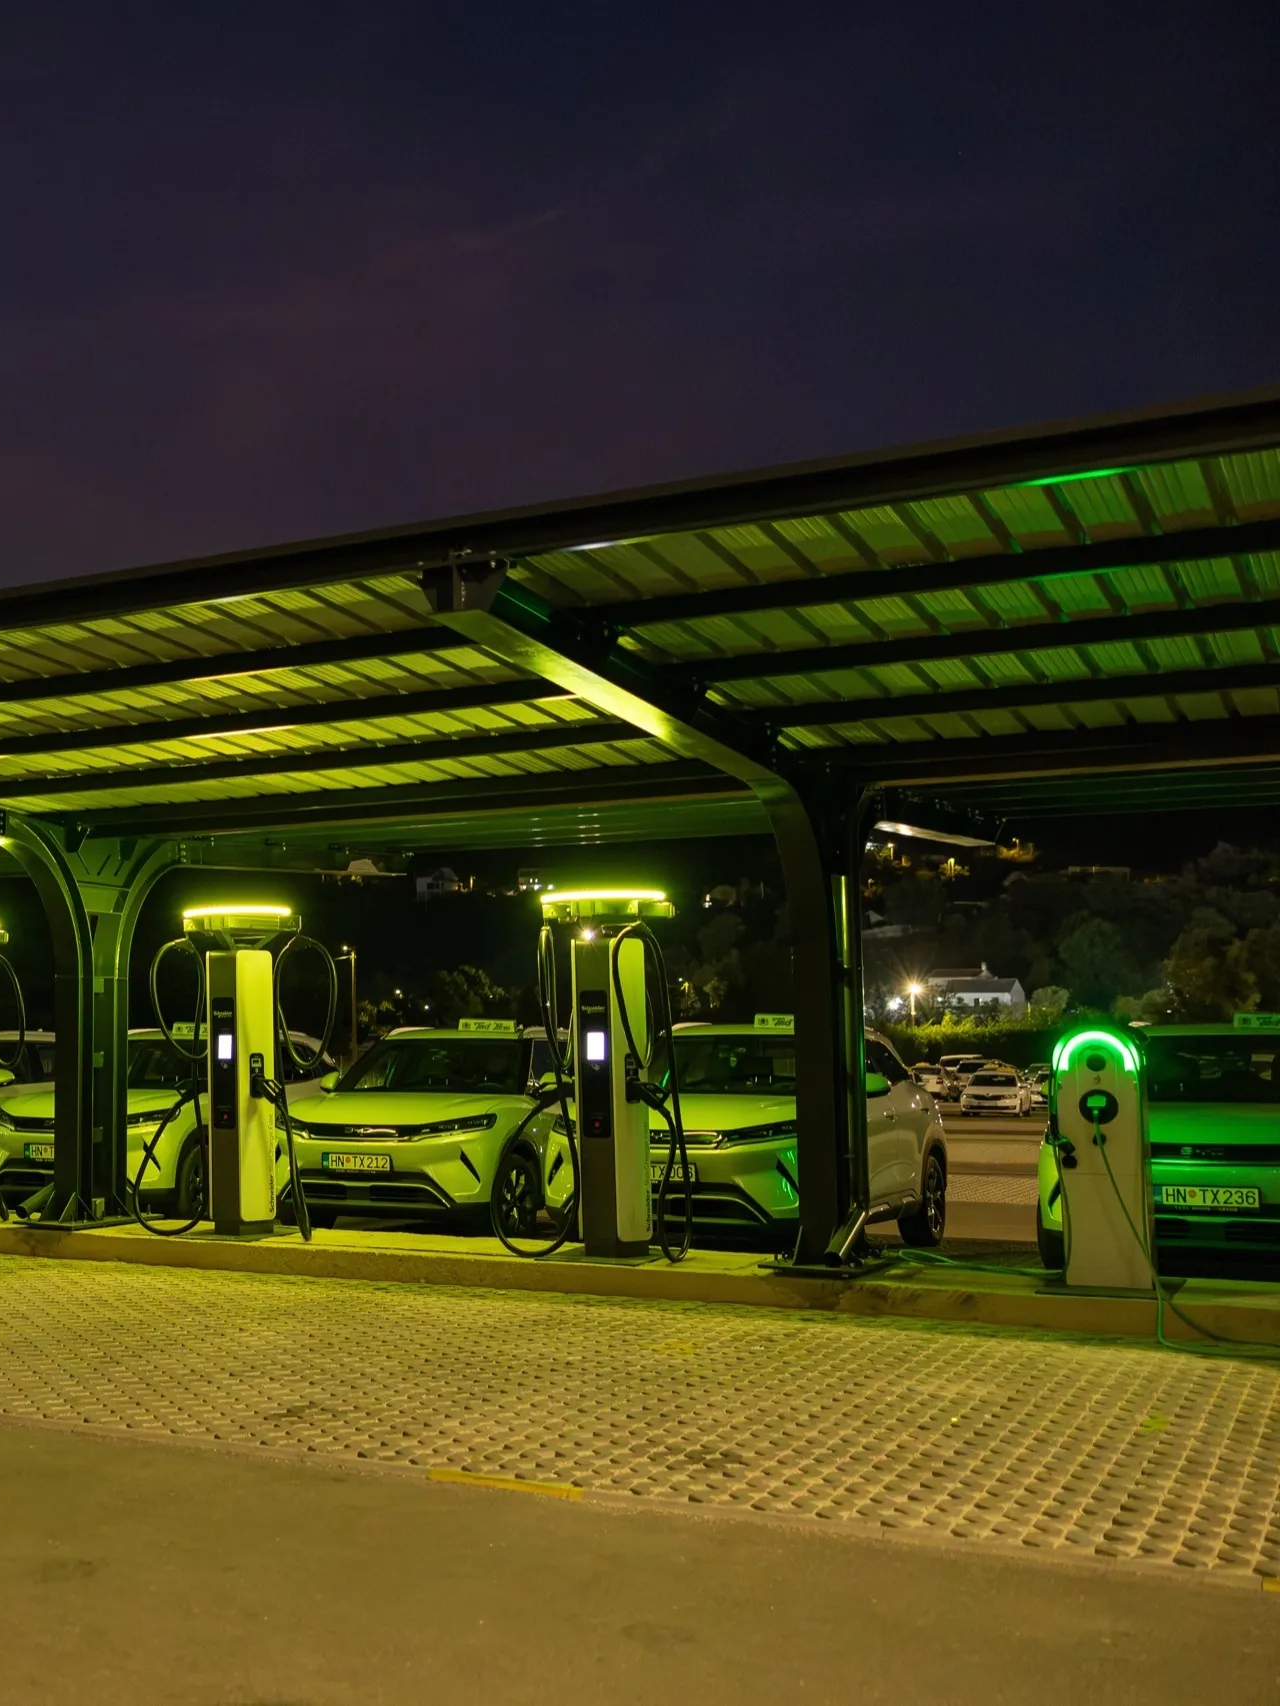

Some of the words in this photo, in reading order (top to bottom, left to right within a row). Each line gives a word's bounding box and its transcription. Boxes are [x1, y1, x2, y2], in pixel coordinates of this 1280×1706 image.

[31, 1145, 42, 1157] HN
[330, 1155, 345, 1168] HN
[352, 1156, 388, 1169] TX212
[1165, 1188, 1187, 1203] HN
[1199, 1189, 1257, 1205] TX236
